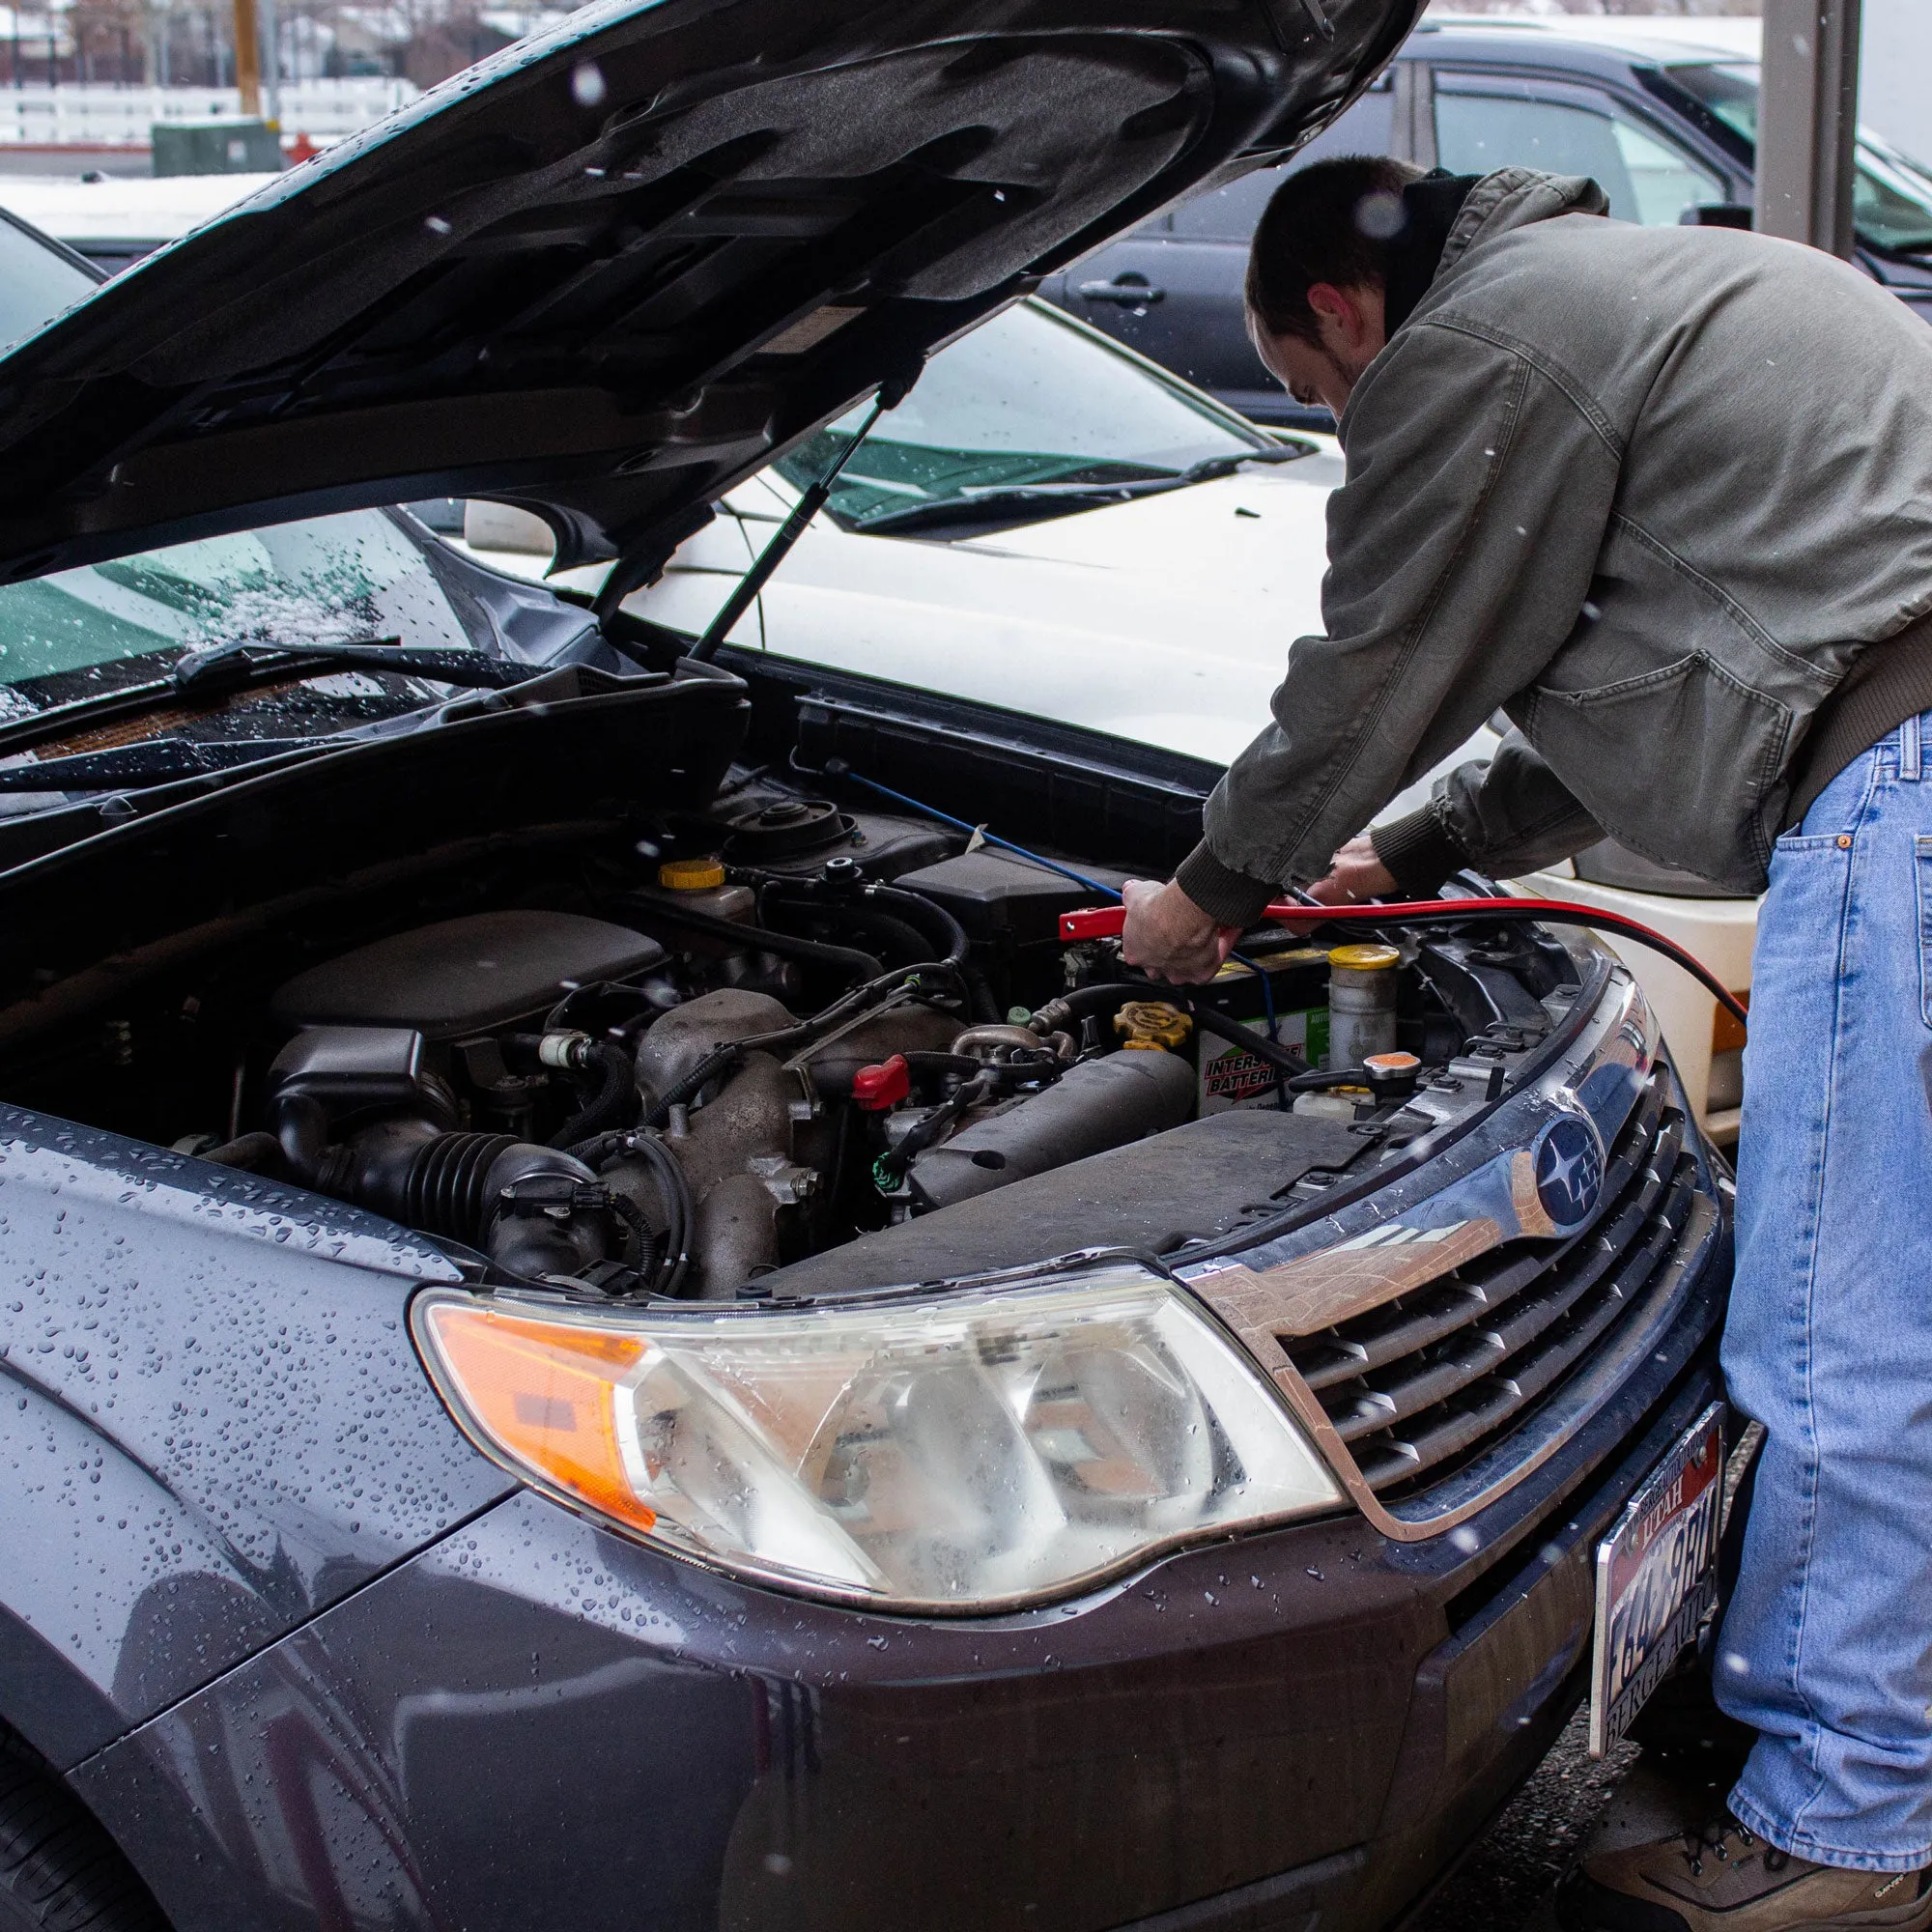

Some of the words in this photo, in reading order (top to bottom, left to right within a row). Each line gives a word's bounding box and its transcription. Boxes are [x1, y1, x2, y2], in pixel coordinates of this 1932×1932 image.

[1641, 1474, 1684, 1550] UTAH
[1605, 1641, 1667, 1754] BERGE
[1668, 1571, 1715, 1662] AUTO
